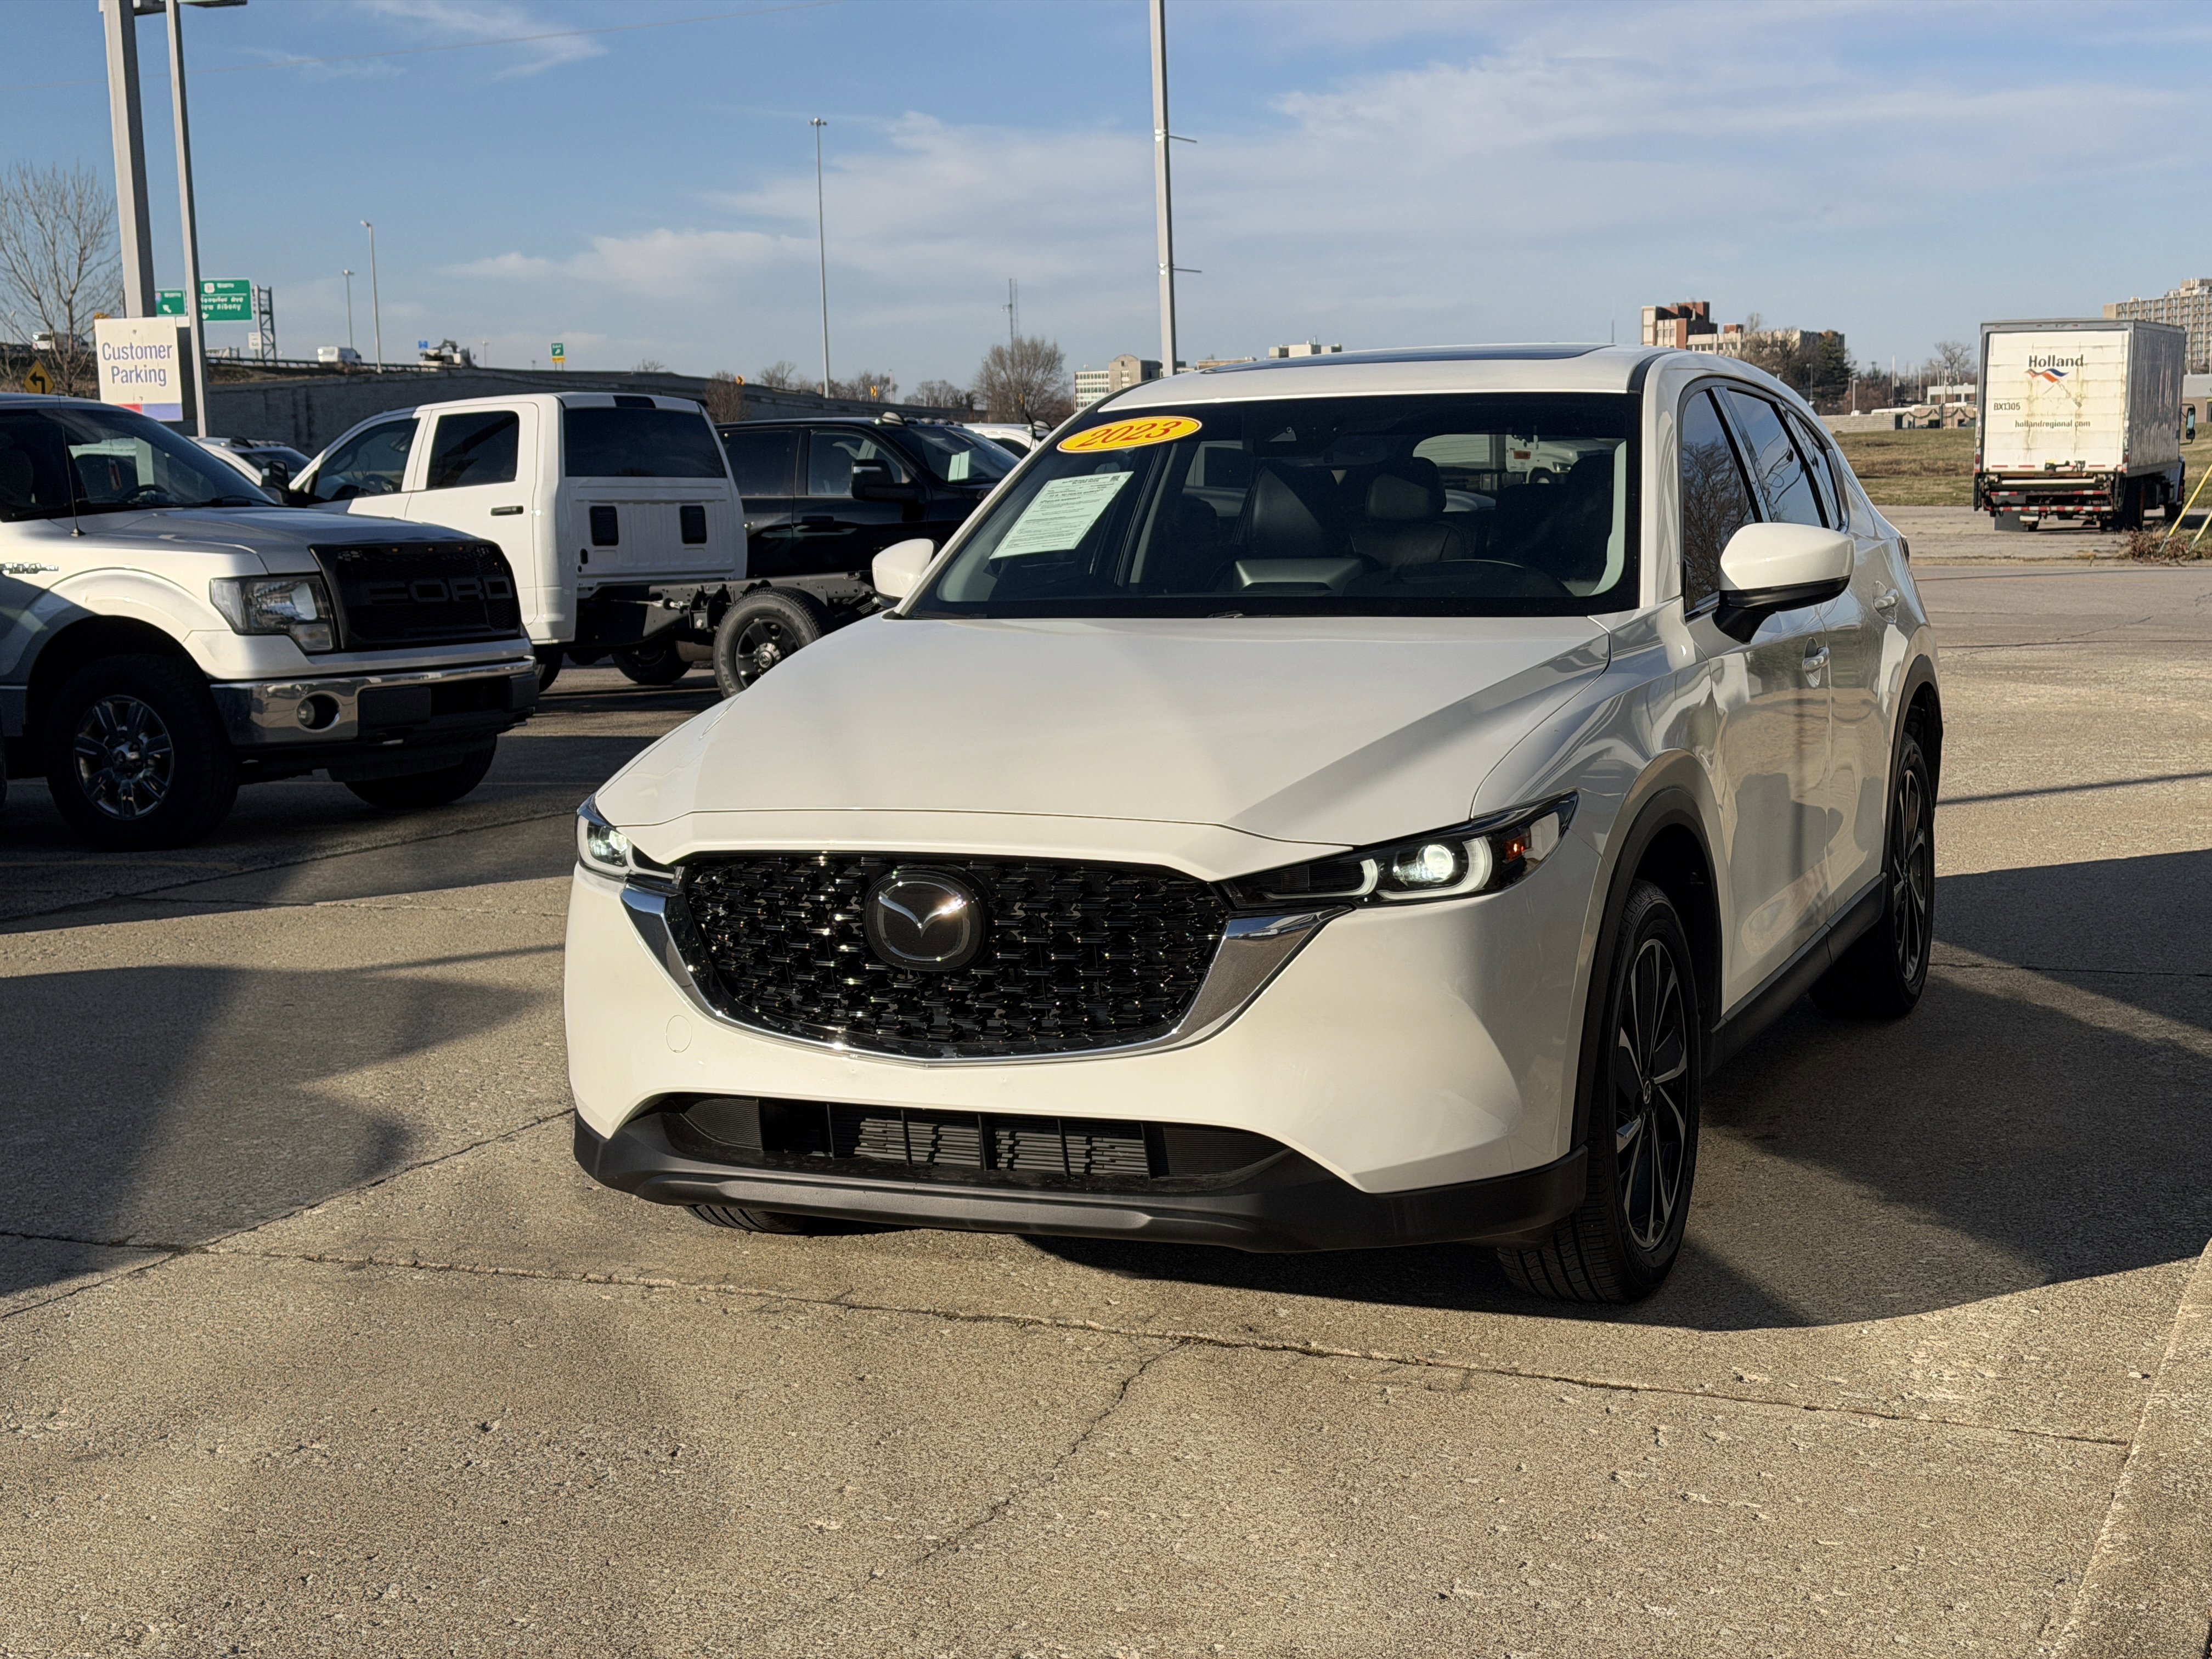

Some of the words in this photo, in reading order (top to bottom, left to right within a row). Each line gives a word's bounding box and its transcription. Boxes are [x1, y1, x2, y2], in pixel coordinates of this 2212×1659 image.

[102, 342, 173, 361] Customer
[2028, 354, 2084, 368] Holland
[111, 364, 167, 387] Parking
[1075, 421, 1182, 448] 2023
[358, 574, 514, 606] FORD
